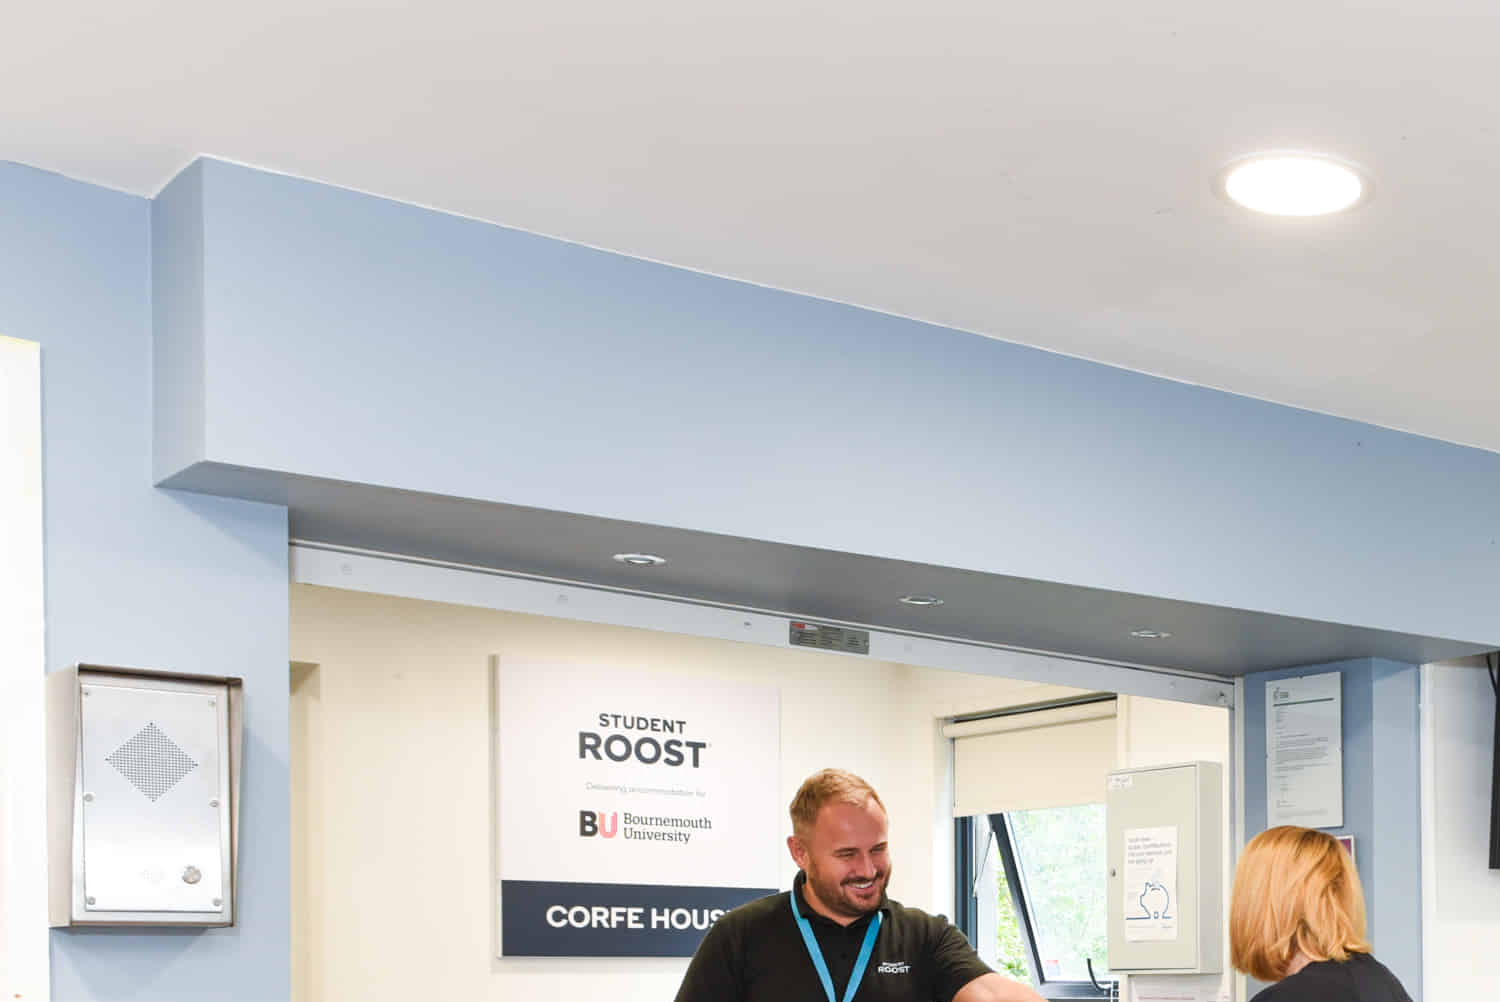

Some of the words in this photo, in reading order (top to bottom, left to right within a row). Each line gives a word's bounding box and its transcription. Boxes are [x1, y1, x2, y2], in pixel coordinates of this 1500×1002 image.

[599, 713, 686, 734] STUDENT
[578, 731, 706, 768] ROOST
[579, 810, 618, 838] BU
[623, 812, 712, 829] Bournemouth
[623, 827, 691, 844] University
[546, 905, 645, 928] CORFE
[651, 908, 731, 930] HOUS
